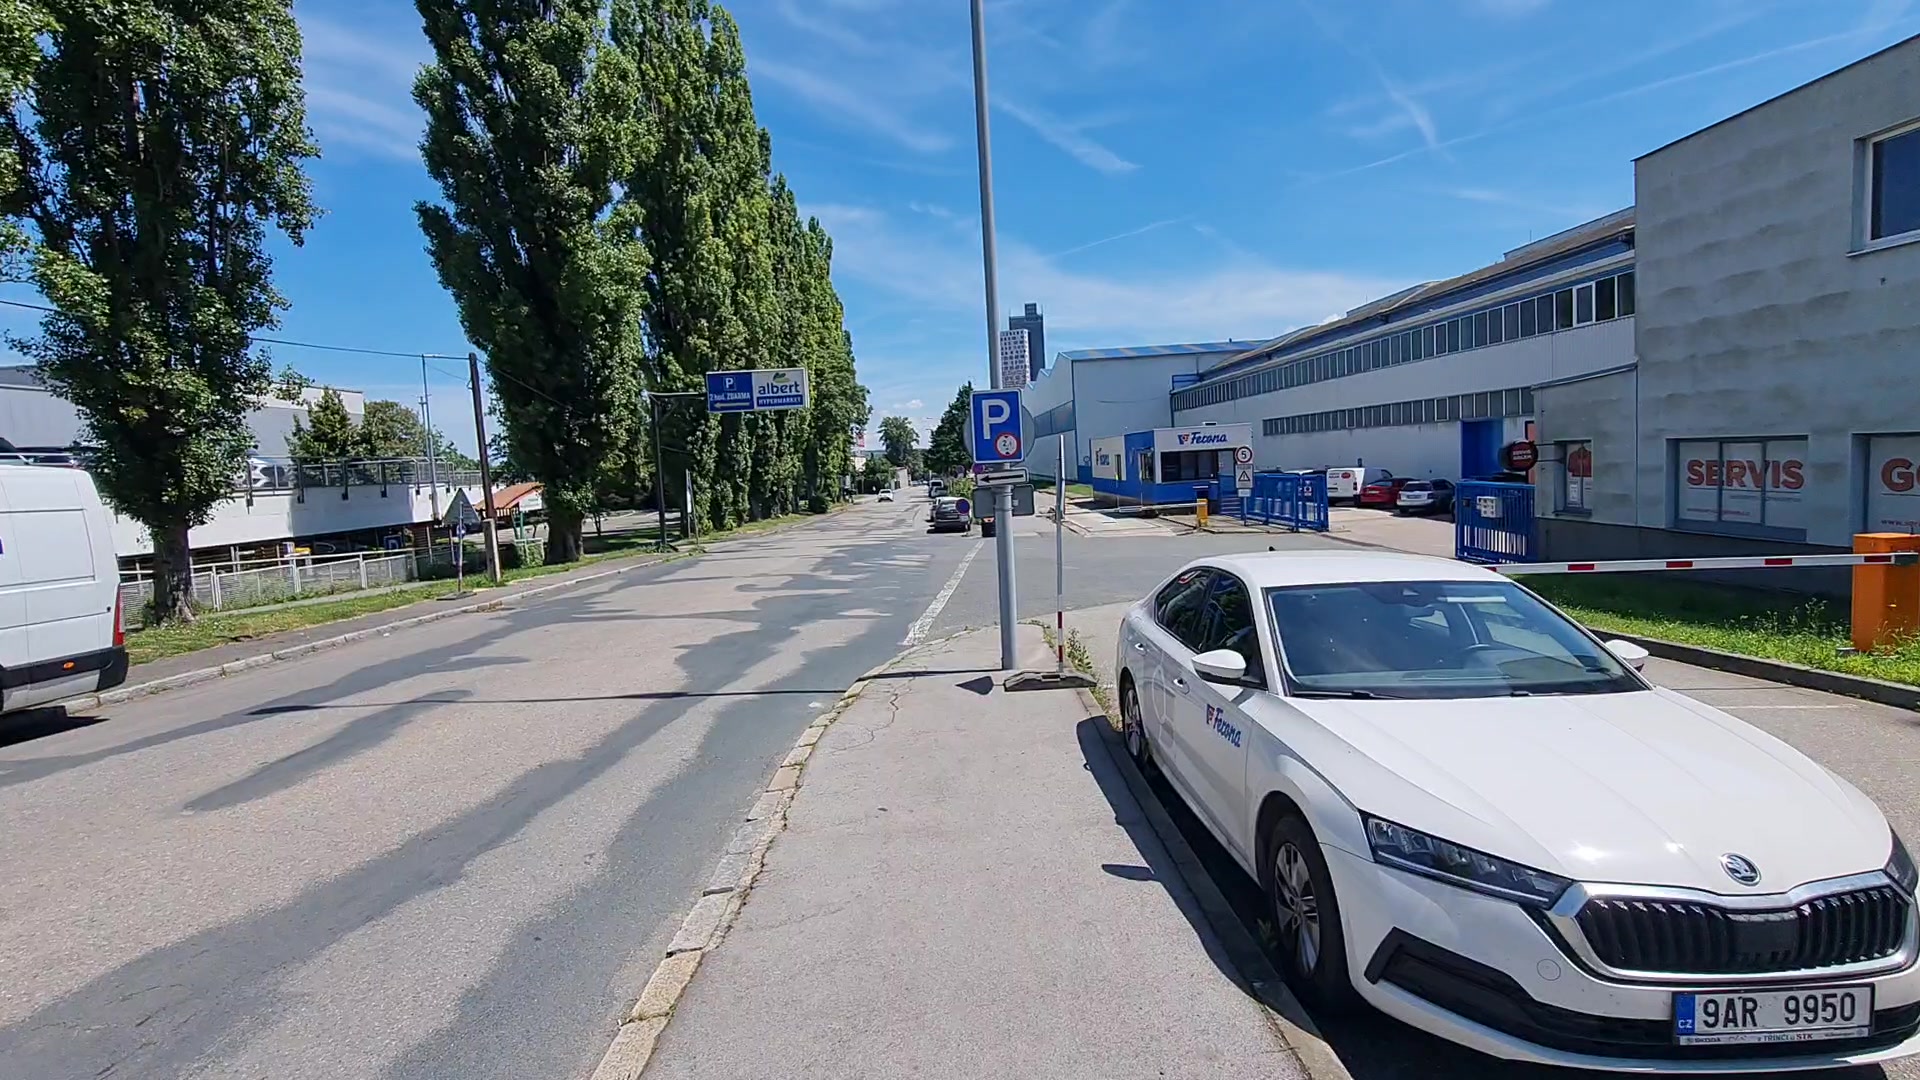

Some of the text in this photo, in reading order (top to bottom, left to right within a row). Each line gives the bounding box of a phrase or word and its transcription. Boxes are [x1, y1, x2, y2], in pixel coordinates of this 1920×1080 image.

[725, 377, 734, 389] P
[758, 381, 801, 395] albert
[726, 392, 751, 400] ZDARMA
[758, 396, 801, 405] HYPERMARKET
[982, 399, 1010, 440] P
[1190, 431, 1228, 445] Fecona
[1241, 450, 1247, 459] 5
[1686, 459, 1805, 490] SERVIS
[1881, 457, 1920, 492] G
[1213, 707, 1241, 748] Fecona
[1703, 992, 1856, 1028] 9AR 9950
[1678, 1019, 1693, 1030] CZ
